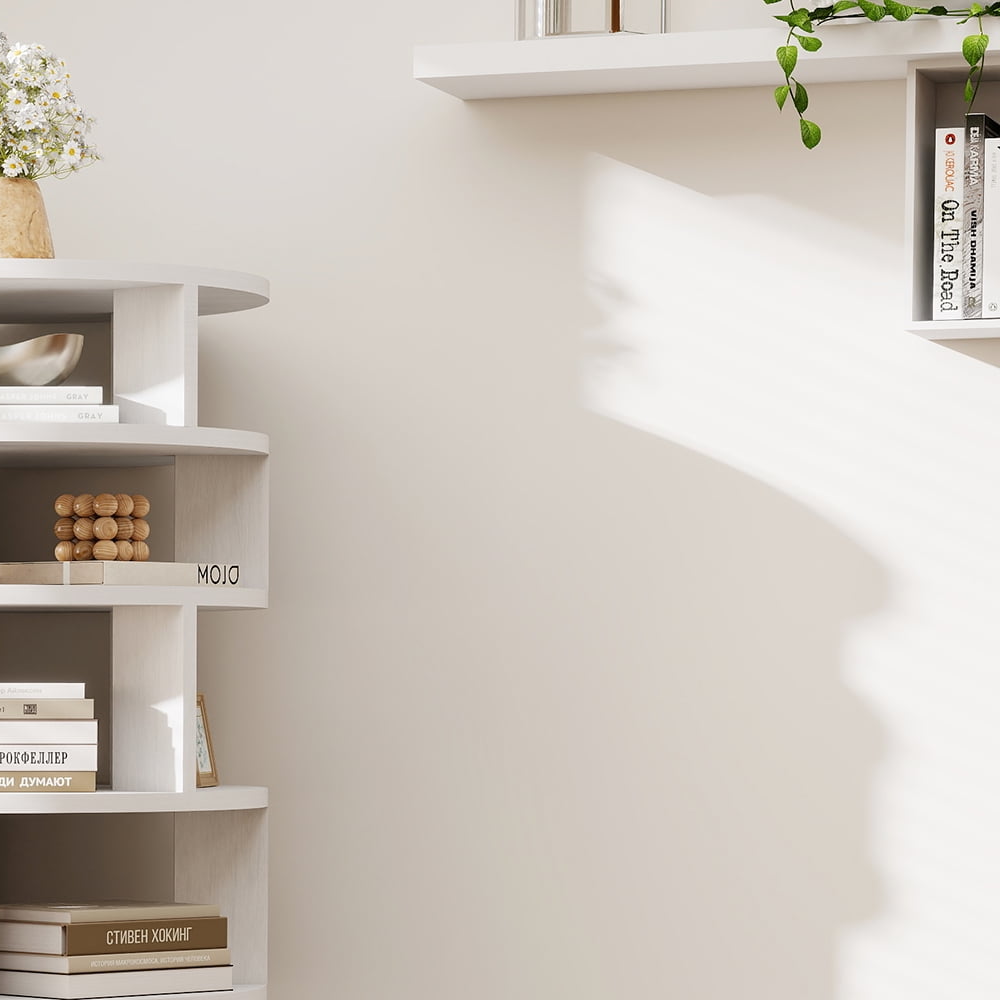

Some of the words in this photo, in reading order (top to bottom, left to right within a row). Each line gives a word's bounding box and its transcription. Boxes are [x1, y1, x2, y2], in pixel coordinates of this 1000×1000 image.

[941, 200, 959, 223] On
[941, 229, 959, 262] The
[969, 240, 977, 289] DHAMIJA
[941, 269, 959, 312] Road
[78, 412, 103, 420] GRAY
[0, 751, 68, 765] РОКФЕЛЛЕР
[19, 777, 73, 788] ДУМАЮТ
[106, 928, 149, 945] СТИВЕН
[151, 927, 192, 943] ХОКИНГ
